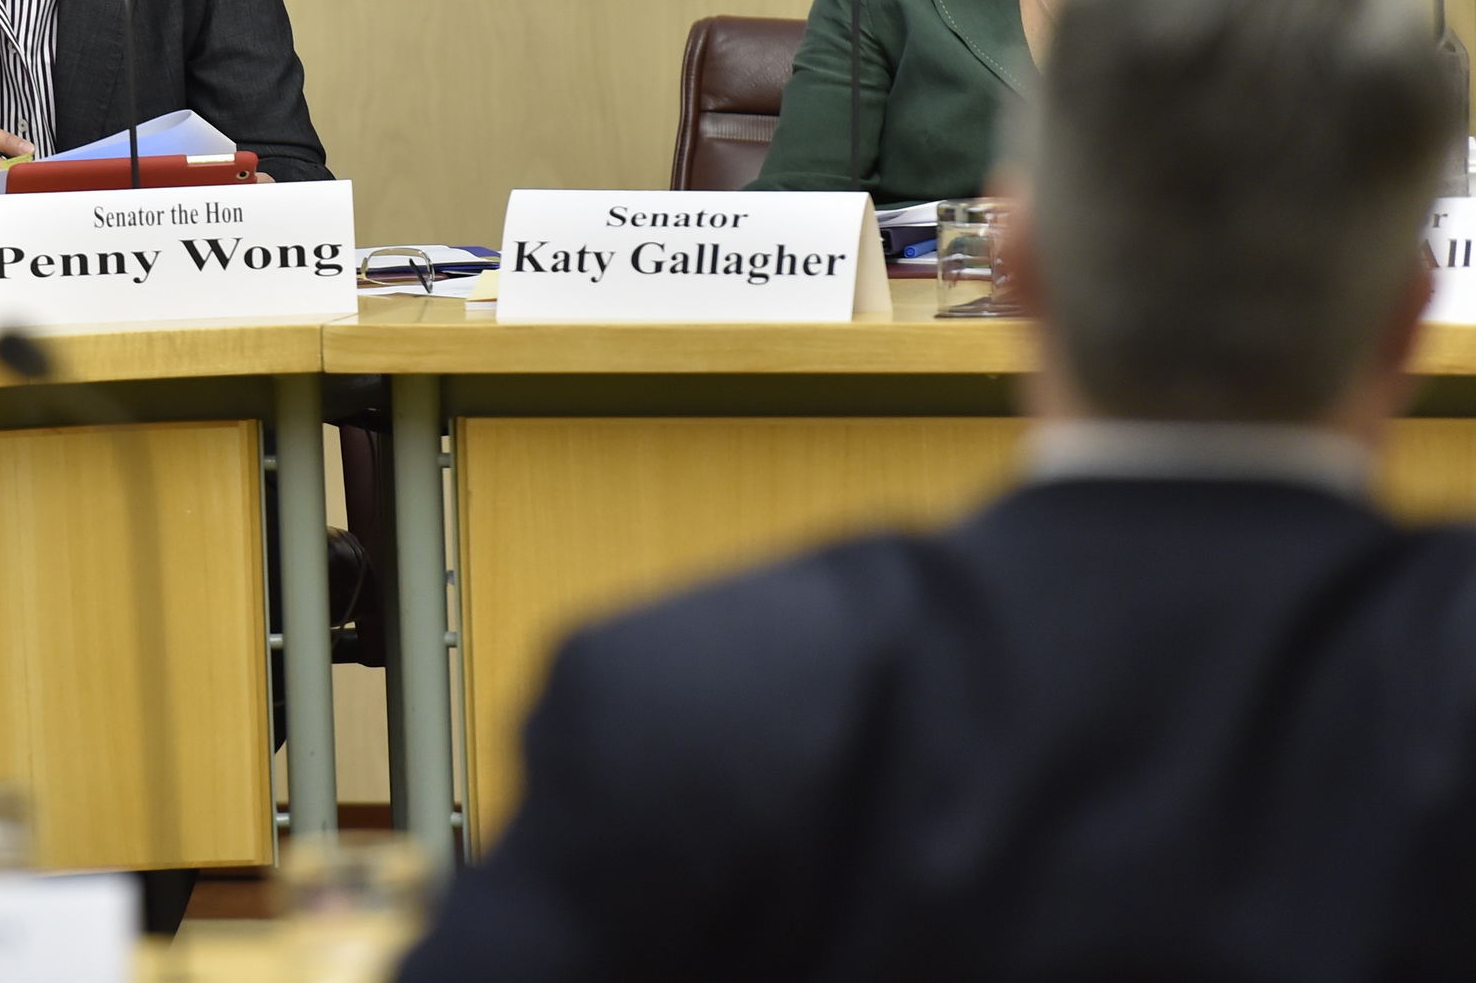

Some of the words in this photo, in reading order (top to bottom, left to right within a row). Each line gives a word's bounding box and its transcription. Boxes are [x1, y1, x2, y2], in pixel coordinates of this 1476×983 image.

[93, 206, 165, 229] Senator
[170, 203, 199, 226] the
[205, 201, 244, 224] Hon
[606, 205, 749, 230] Senator
[178, 237, 344, 278] Wong
[511, 240, 616, 284] Katy
[630, 241, 847, 286] Gallagher
